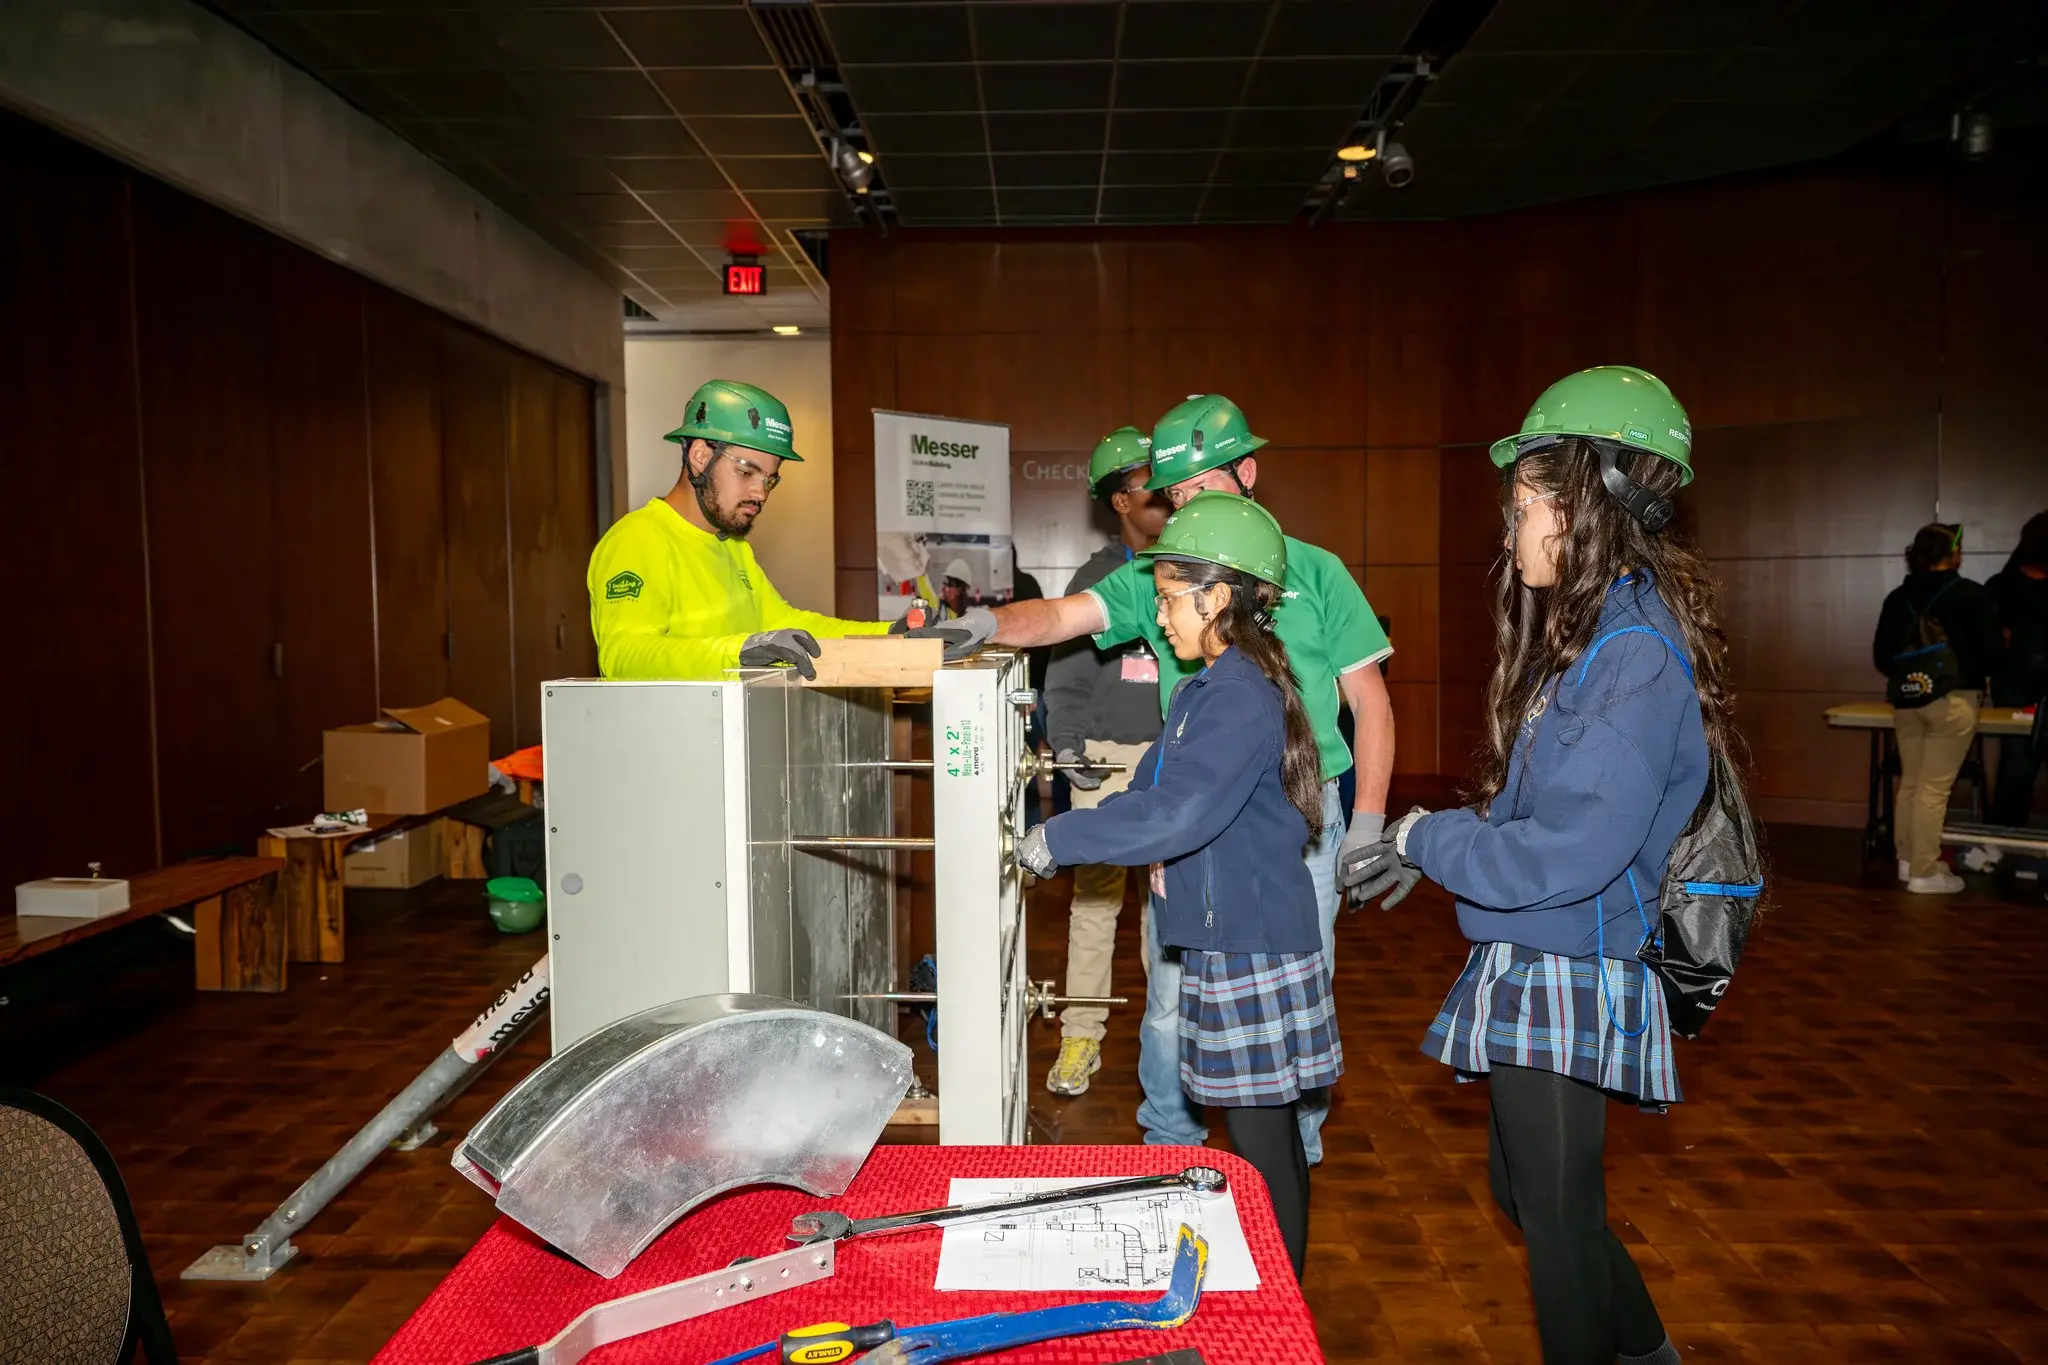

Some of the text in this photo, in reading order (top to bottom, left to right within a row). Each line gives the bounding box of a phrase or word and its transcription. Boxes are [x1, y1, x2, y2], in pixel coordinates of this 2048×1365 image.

[729, 266, 762, 293] EXIT
[1629, 430, 1649, 441] MSA
[911, 434, 979, 460] Messer
[1156, 443, 1187, 460] Messer
[806, 1347, 843, 1360] STANLEY
